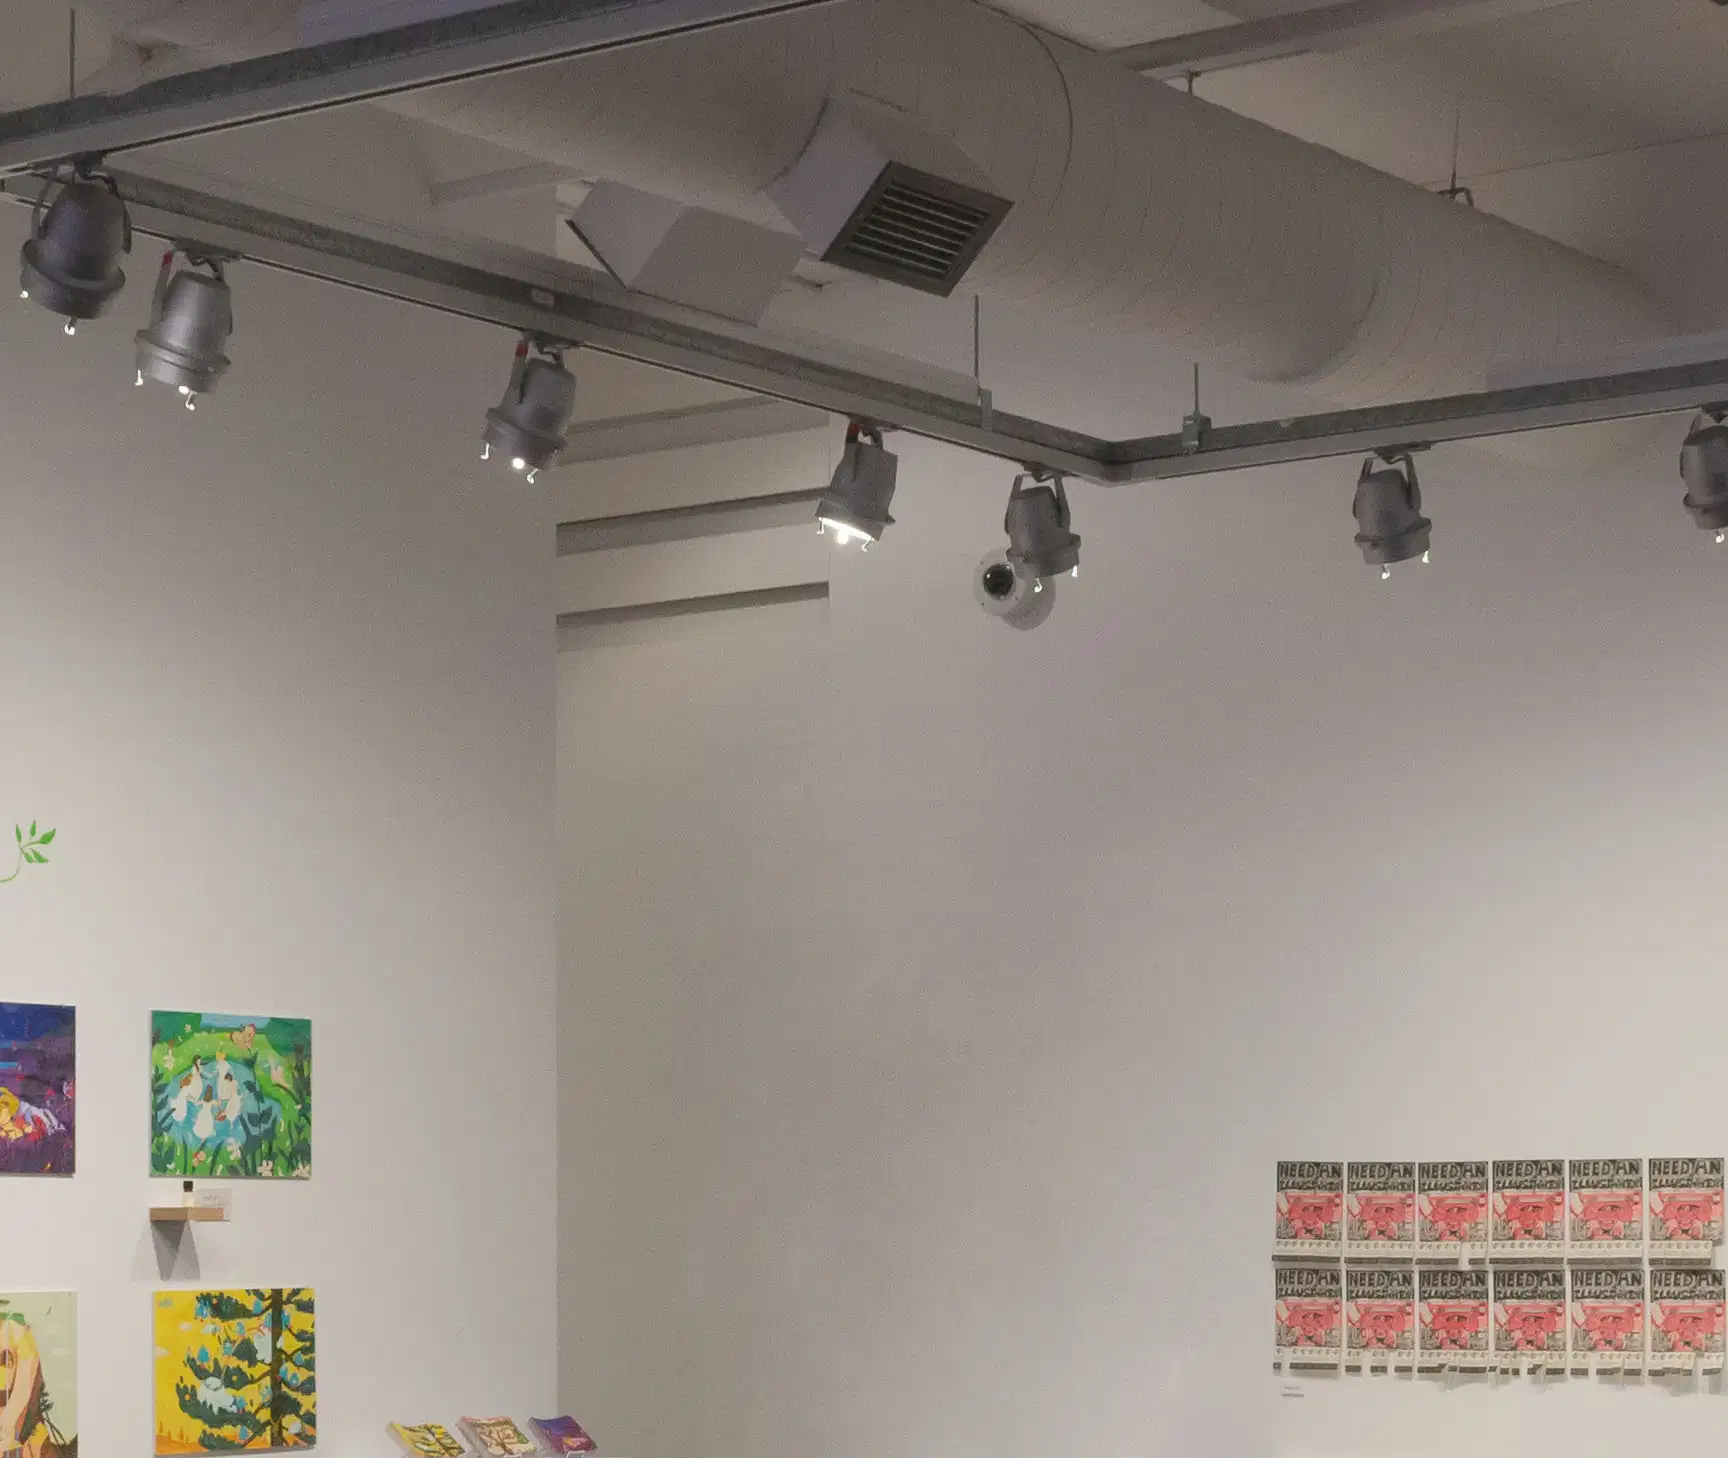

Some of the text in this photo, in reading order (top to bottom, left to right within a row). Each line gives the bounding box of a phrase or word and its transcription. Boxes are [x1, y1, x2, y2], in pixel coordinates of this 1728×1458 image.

[1279, 1164, 1341, 1178] NEED AN
[1350, 1164, 1414, 1178] NEED AN
[1421, 1164, 1486, 1178] NEED AN
[1496, 1162, 1562, 1177] NEED AN
[1574, 1161, 1641, 1177] NEED AN
[1653, 1160, 1721, 1176] NEED AN
[1279, 1271, 1340, 1285] NEED AN
[1350, 1272, 1413, 1286] NEED AN
[1421, 1273, 1486, 1287] NEED AN
[1496, 1272, 1563, 1287] NEED AN
[1575, 1272, 1642, 1286] NEED AN
[1654, 1271, 1722, 1286] NEED AN
